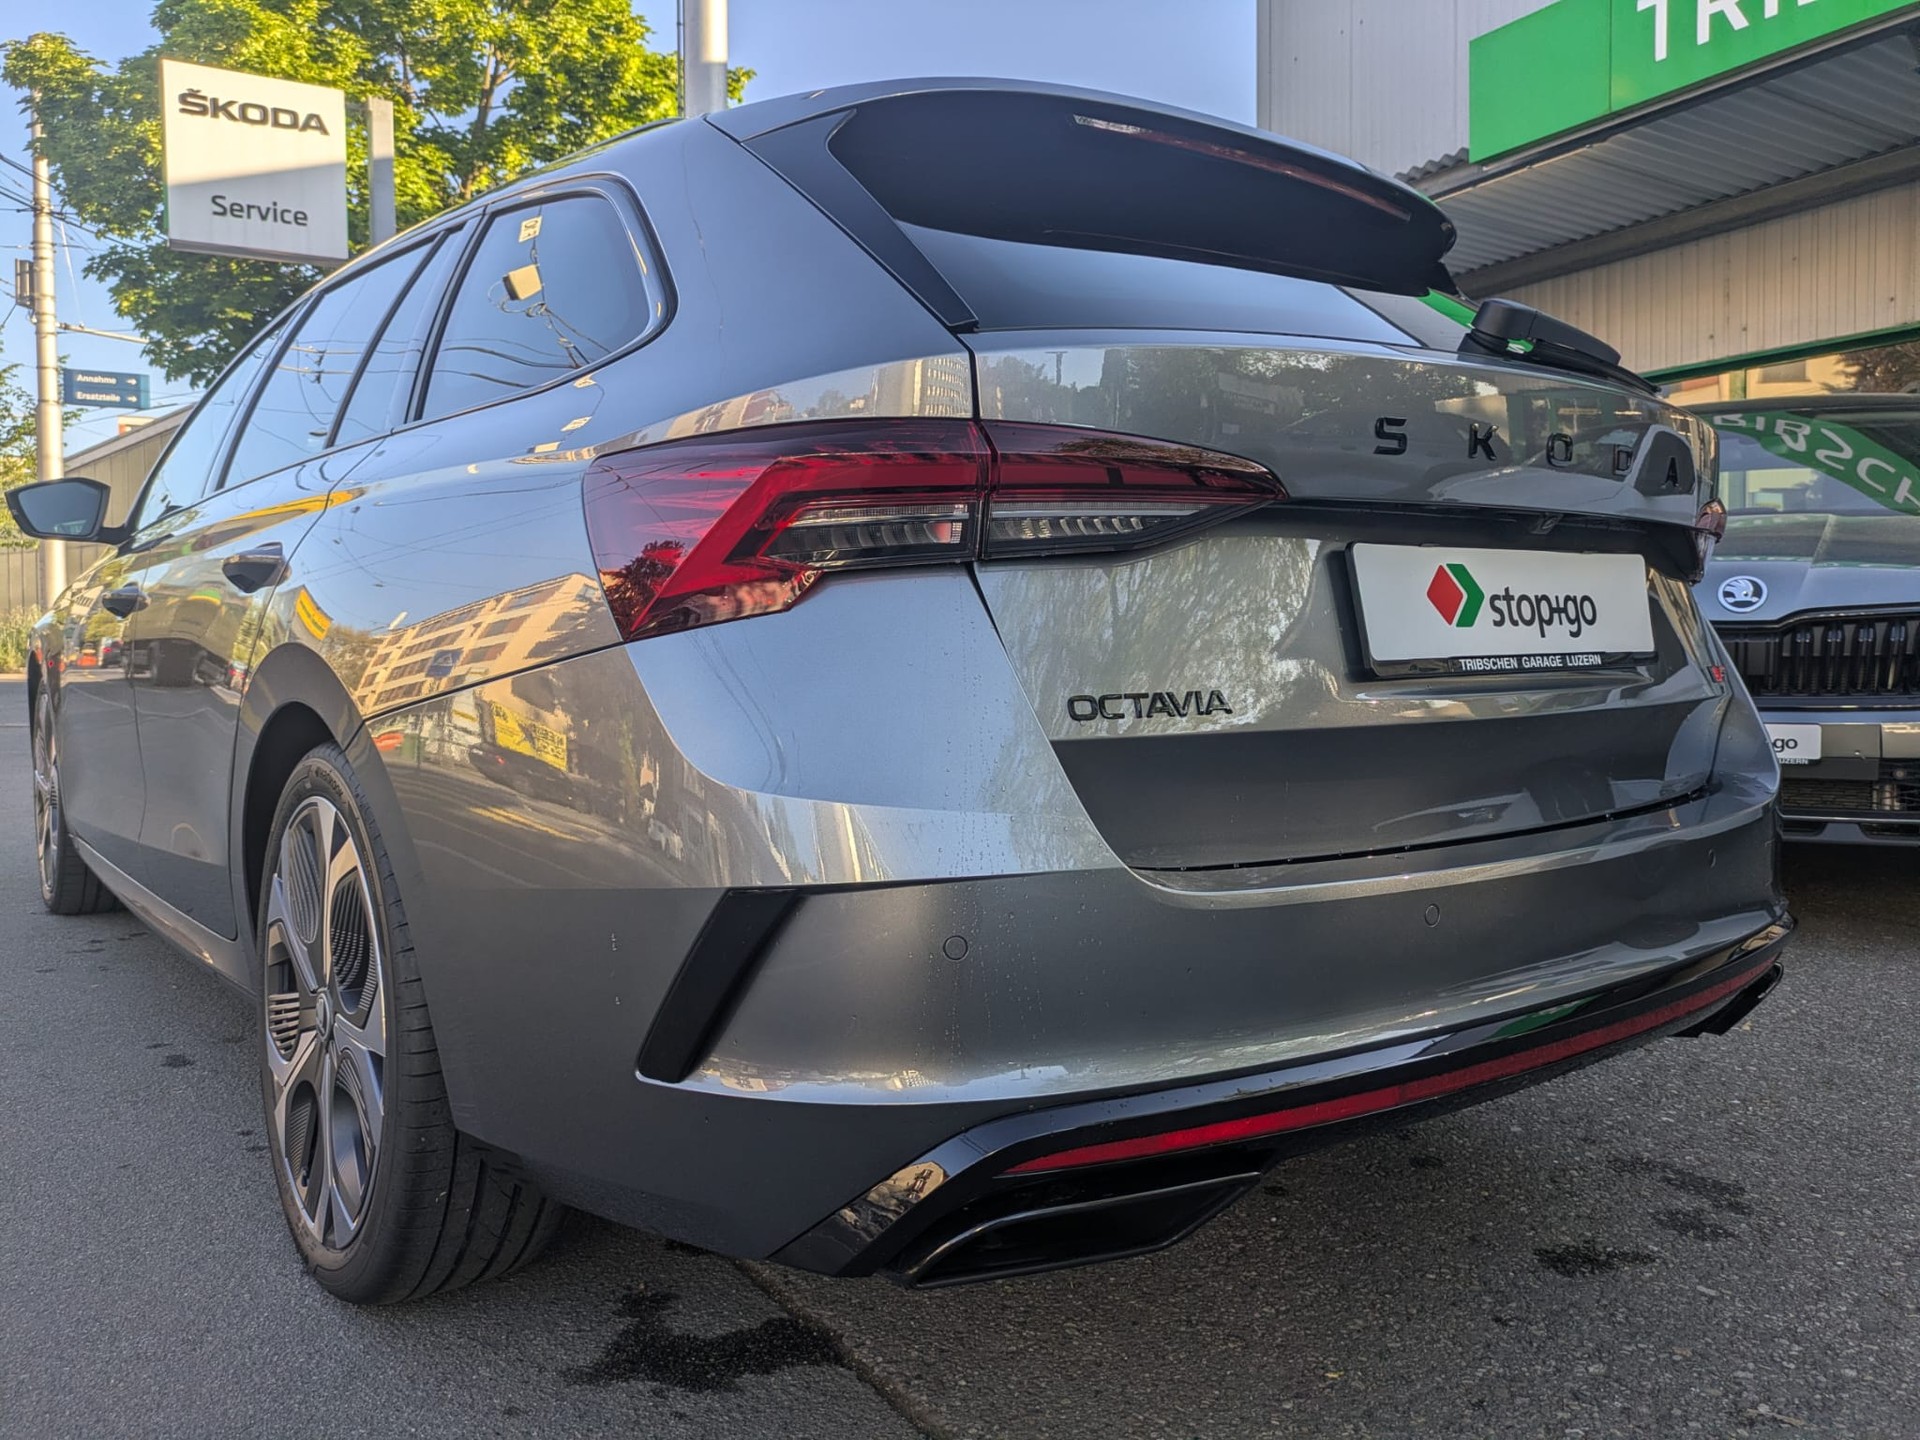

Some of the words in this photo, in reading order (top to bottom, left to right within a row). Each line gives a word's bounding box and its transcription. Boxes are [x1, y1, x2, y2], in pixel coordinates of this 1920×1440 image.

[1636, 0, 1816, 62] TR
[178, 88, 330, 136] ŠKODA
[211, 195, 308, 227] Service
[76, 374, 116, 384] Annahme
[1489, 586, 1597, 638] stop+go
[1459, 657, 1518, 671] TRIBSCHEN
[1521, 655, 1563, 669] GARAGE
[1566, 654, 1602, 667] LUZERN
[1067, 690, 1233, 721] OCTAVIA
[1772, 738, 1798, 753] go
[1778, 757, 1809, 765] UZERN
